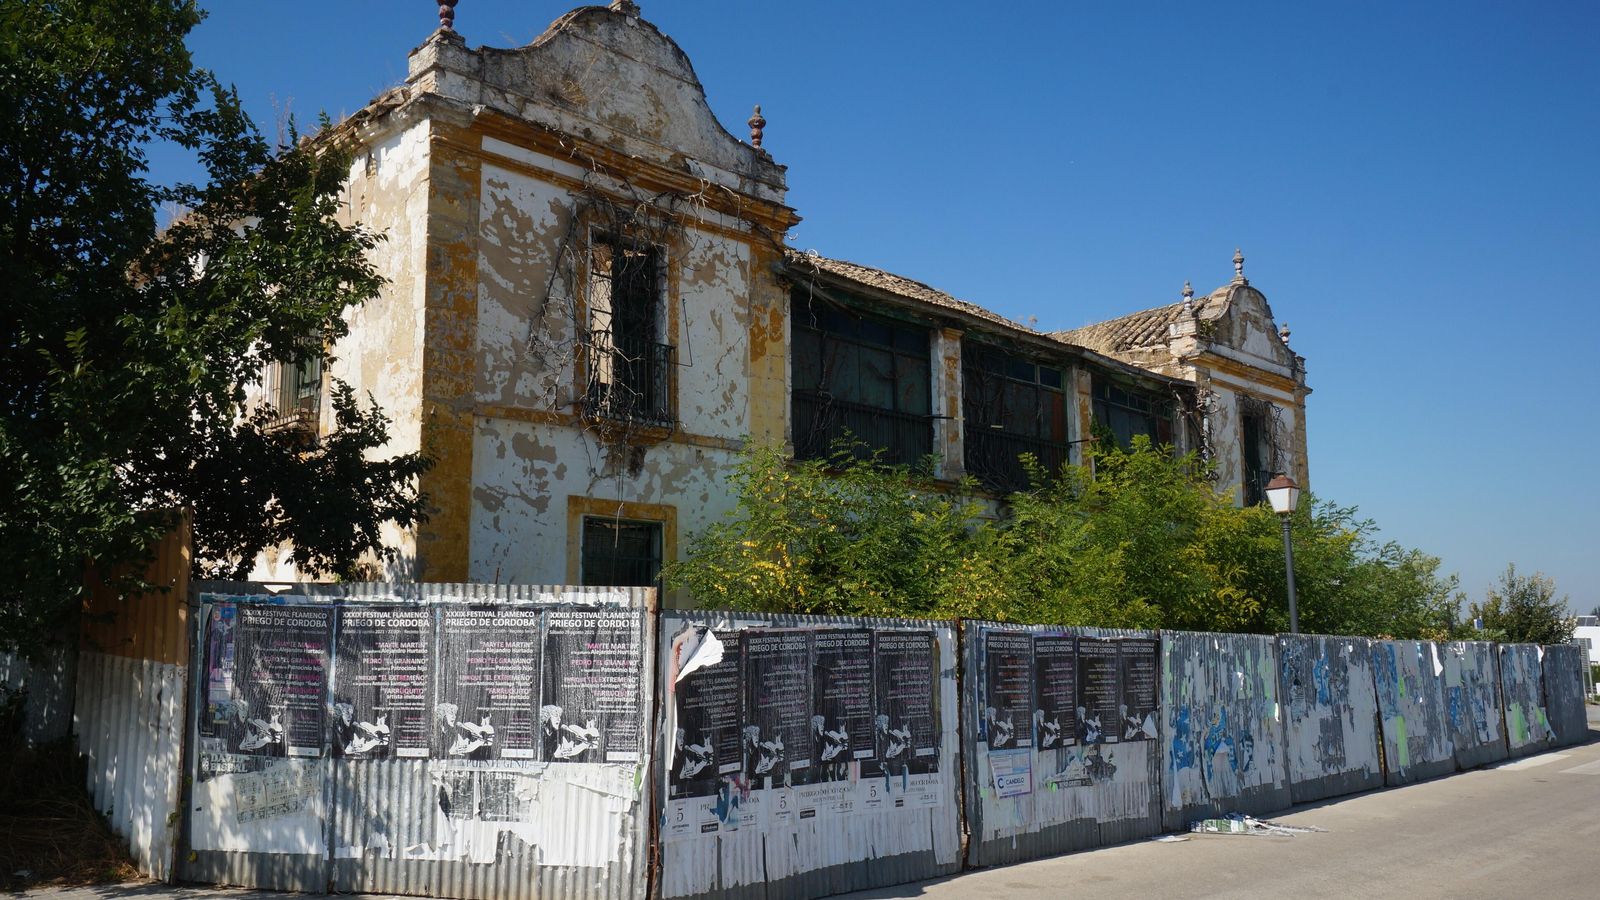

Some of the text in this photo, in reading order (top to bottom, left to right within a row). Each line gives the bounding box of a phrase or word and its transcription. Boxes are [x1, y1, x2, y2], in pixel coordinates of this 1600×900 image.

[242, 617, 328, 627] PRIEGO DE CORDOBA
[342, 619, 430, 627] PRIEGO DE CORDOBA
[550, 620, 641, 628] PRIEGO DE CORDOBA
[716, 632, 741, 641] FLAMENCO
[748, 644, 770, 652] PRIEGO
[770, 643, 778, 651] DE
[870, 785, 877, 798] 5
[779, 795, 787, 810] 5
[676, 807, 685, 822] 5
